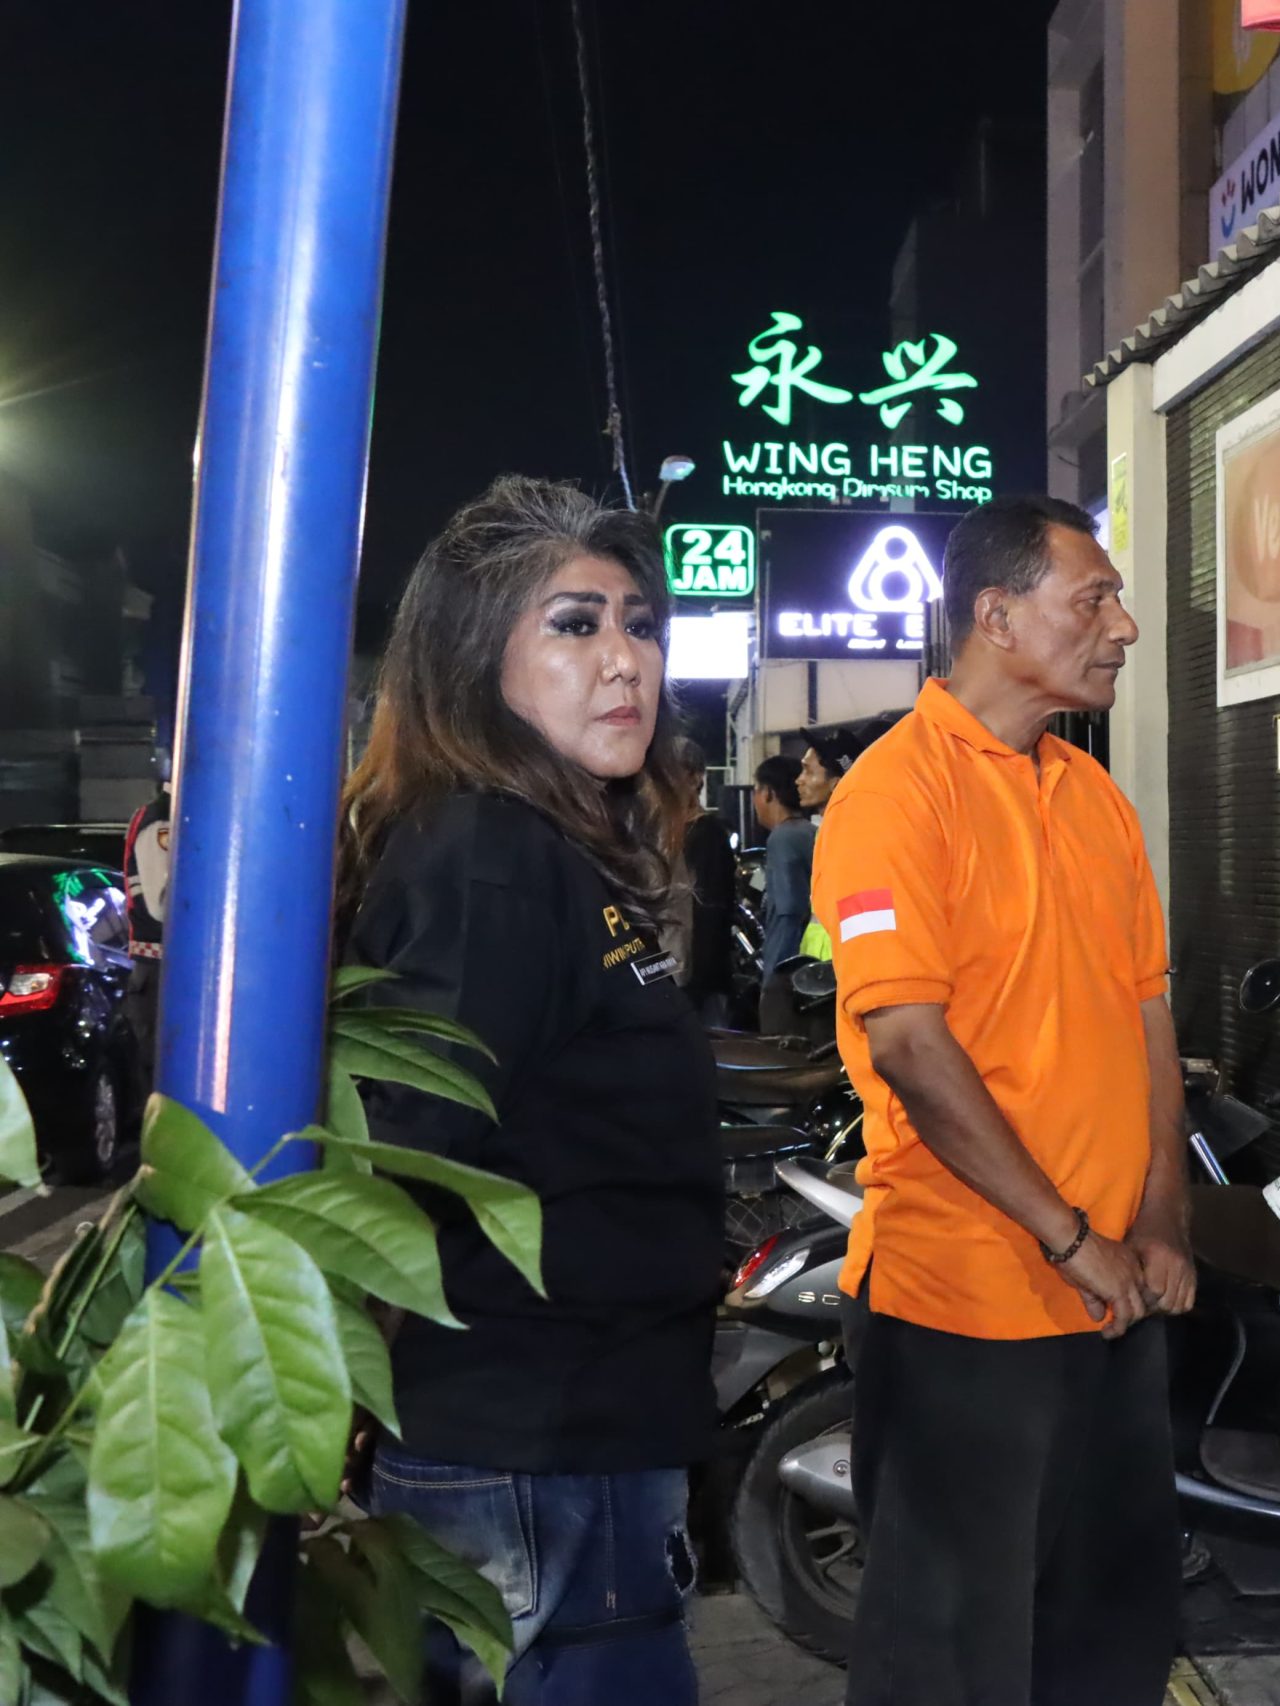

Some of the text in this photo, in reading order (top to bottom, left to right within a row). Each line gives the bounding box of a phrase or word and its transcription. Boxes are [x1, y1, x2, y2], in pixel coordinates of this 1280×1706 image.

[723, 441, 993, 479] WING HENG
[723, 475, 992, 504] Hongkong Dimsum Shop
[681, 529, 747, 565] 24
[673, 566, 747, 591] JAM
[778, 611, 878, 638] ELITE
